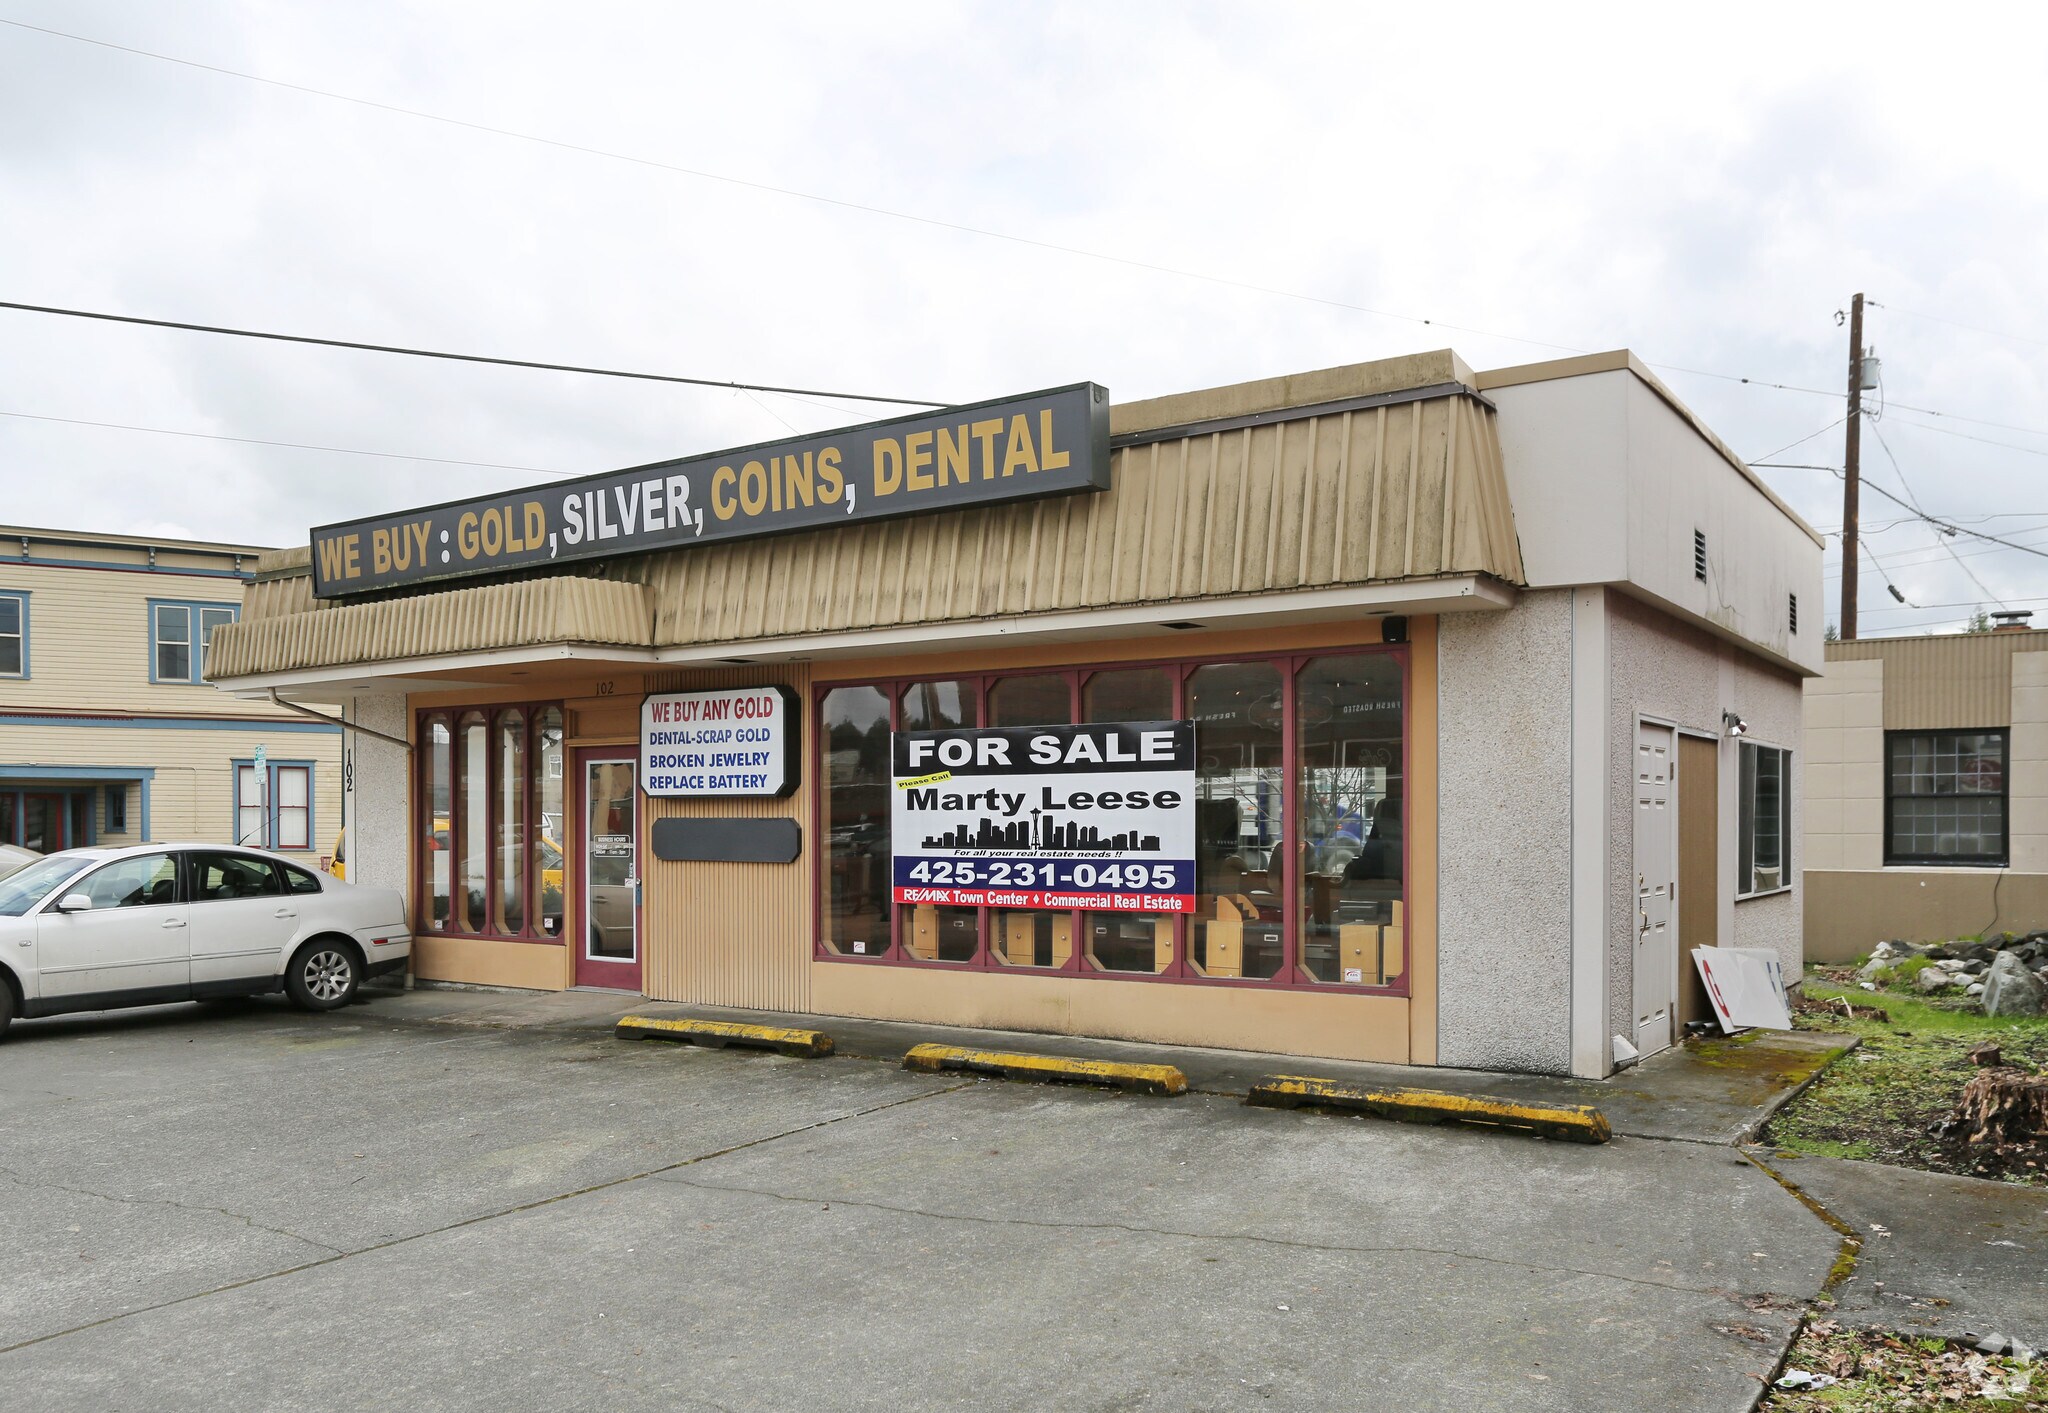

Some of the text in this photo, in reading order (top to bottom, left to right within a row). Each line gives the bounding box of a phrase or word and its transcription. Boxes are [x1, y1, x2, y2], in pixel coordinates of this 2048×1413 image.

[318, 533, 362, 583] WE
[872, 408, 1070, 497] DENTAL
[595, 681, 614, 695] 102
[651, 696, 774, 723] WE BUY ANY GOLD
[650, 727, 771, 746] DENTAL-SCRAP GOLD
[650, 751, 770, 768] BROKEN JEWELRY
[909, 730, 1176, 768] FOR SALE
[649, 774, 768, 789] REPLACE BATTERY
[899, 773, 949, 788] Please Call
[906, 786, 1182, 817] Marty Leese
[972, 849, 987, 857] all
[988, 850, 1014, 859] your
[1015, 850, 1038, 858] real
[1040, 850, 1074, 858] estate
[1076, 850, 1111, 858] needs
[909, 860, 1177, 890] 425-231-0495
[903, 887, 1183, 911] RE/MAX Town Center Commercial Real Estate
